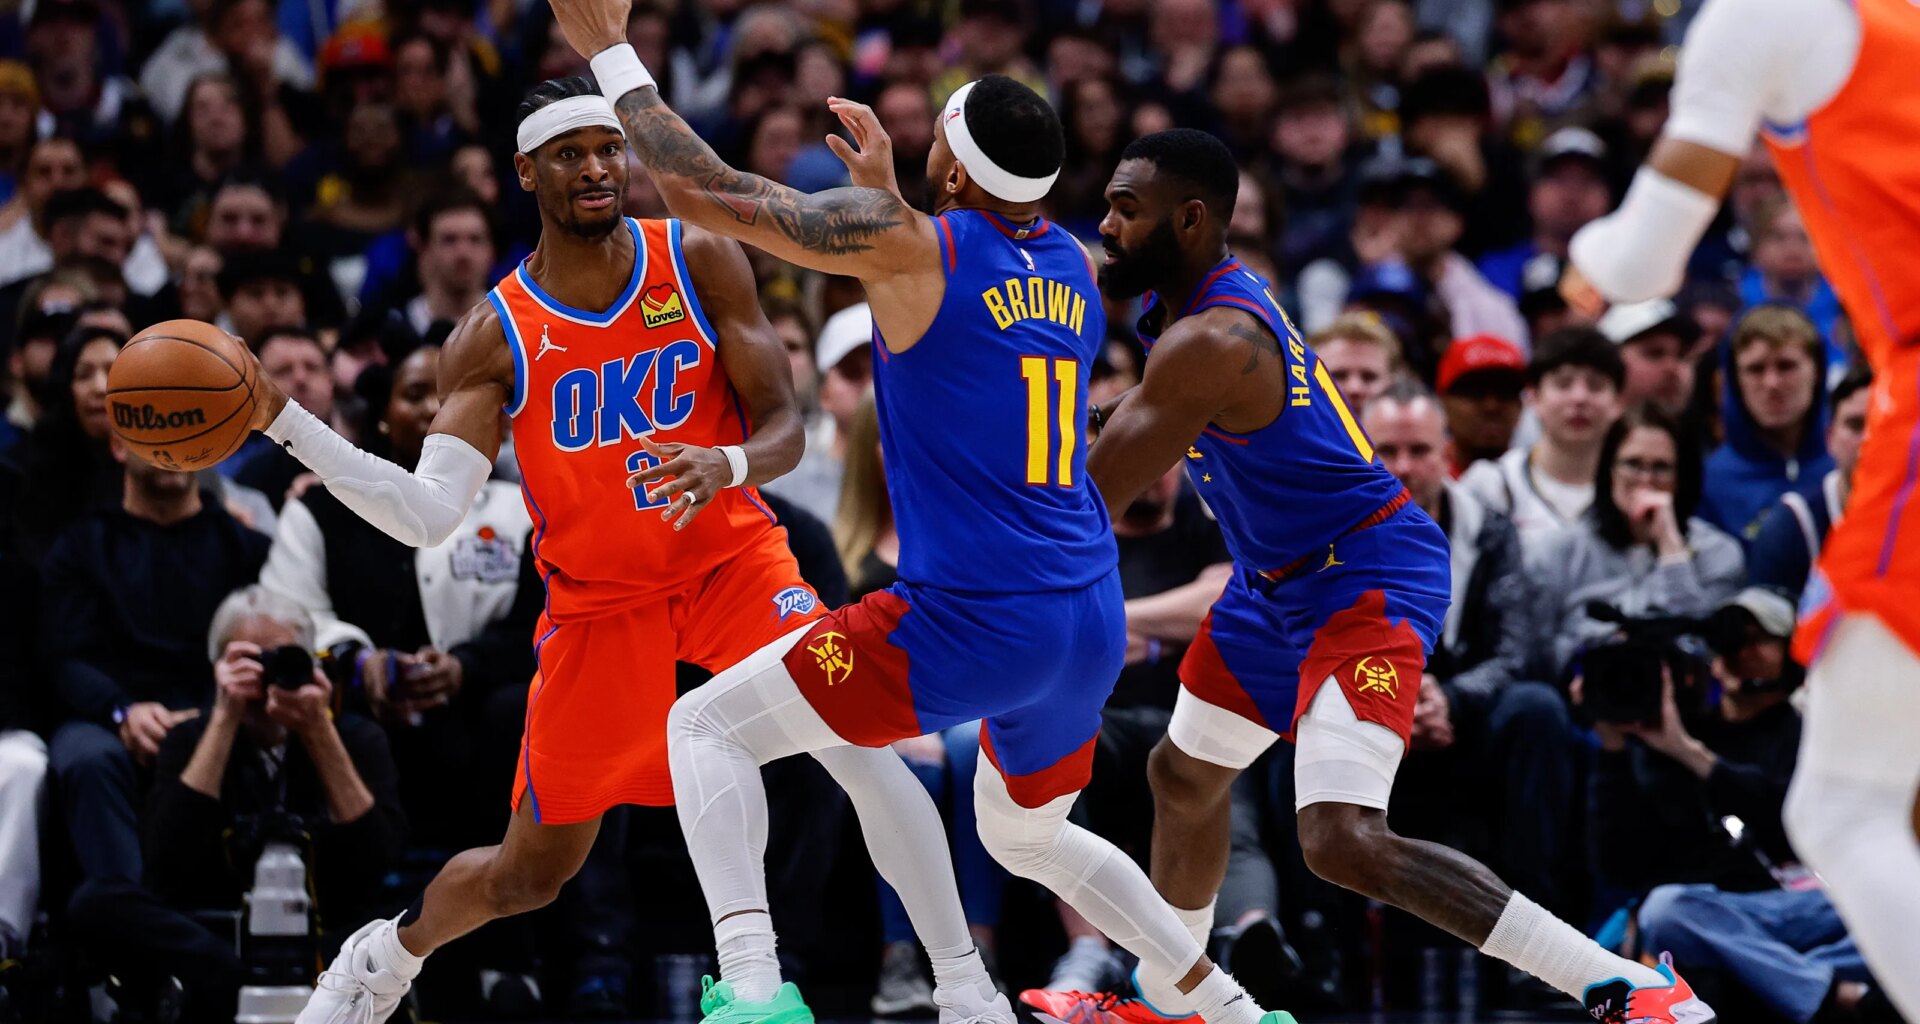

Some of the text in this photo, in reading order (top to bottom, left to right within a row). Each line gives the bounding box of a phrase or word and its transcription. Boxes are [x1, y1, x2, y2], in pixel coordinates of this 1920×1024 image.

[982, 277, 1086, 337] BROWN
[112, 401, 207, 430] Wilson
[551, 339, 700, 452] OKC
[1019, 354, 1078, 488] 11
[780, 592, 809, 617] OKC
